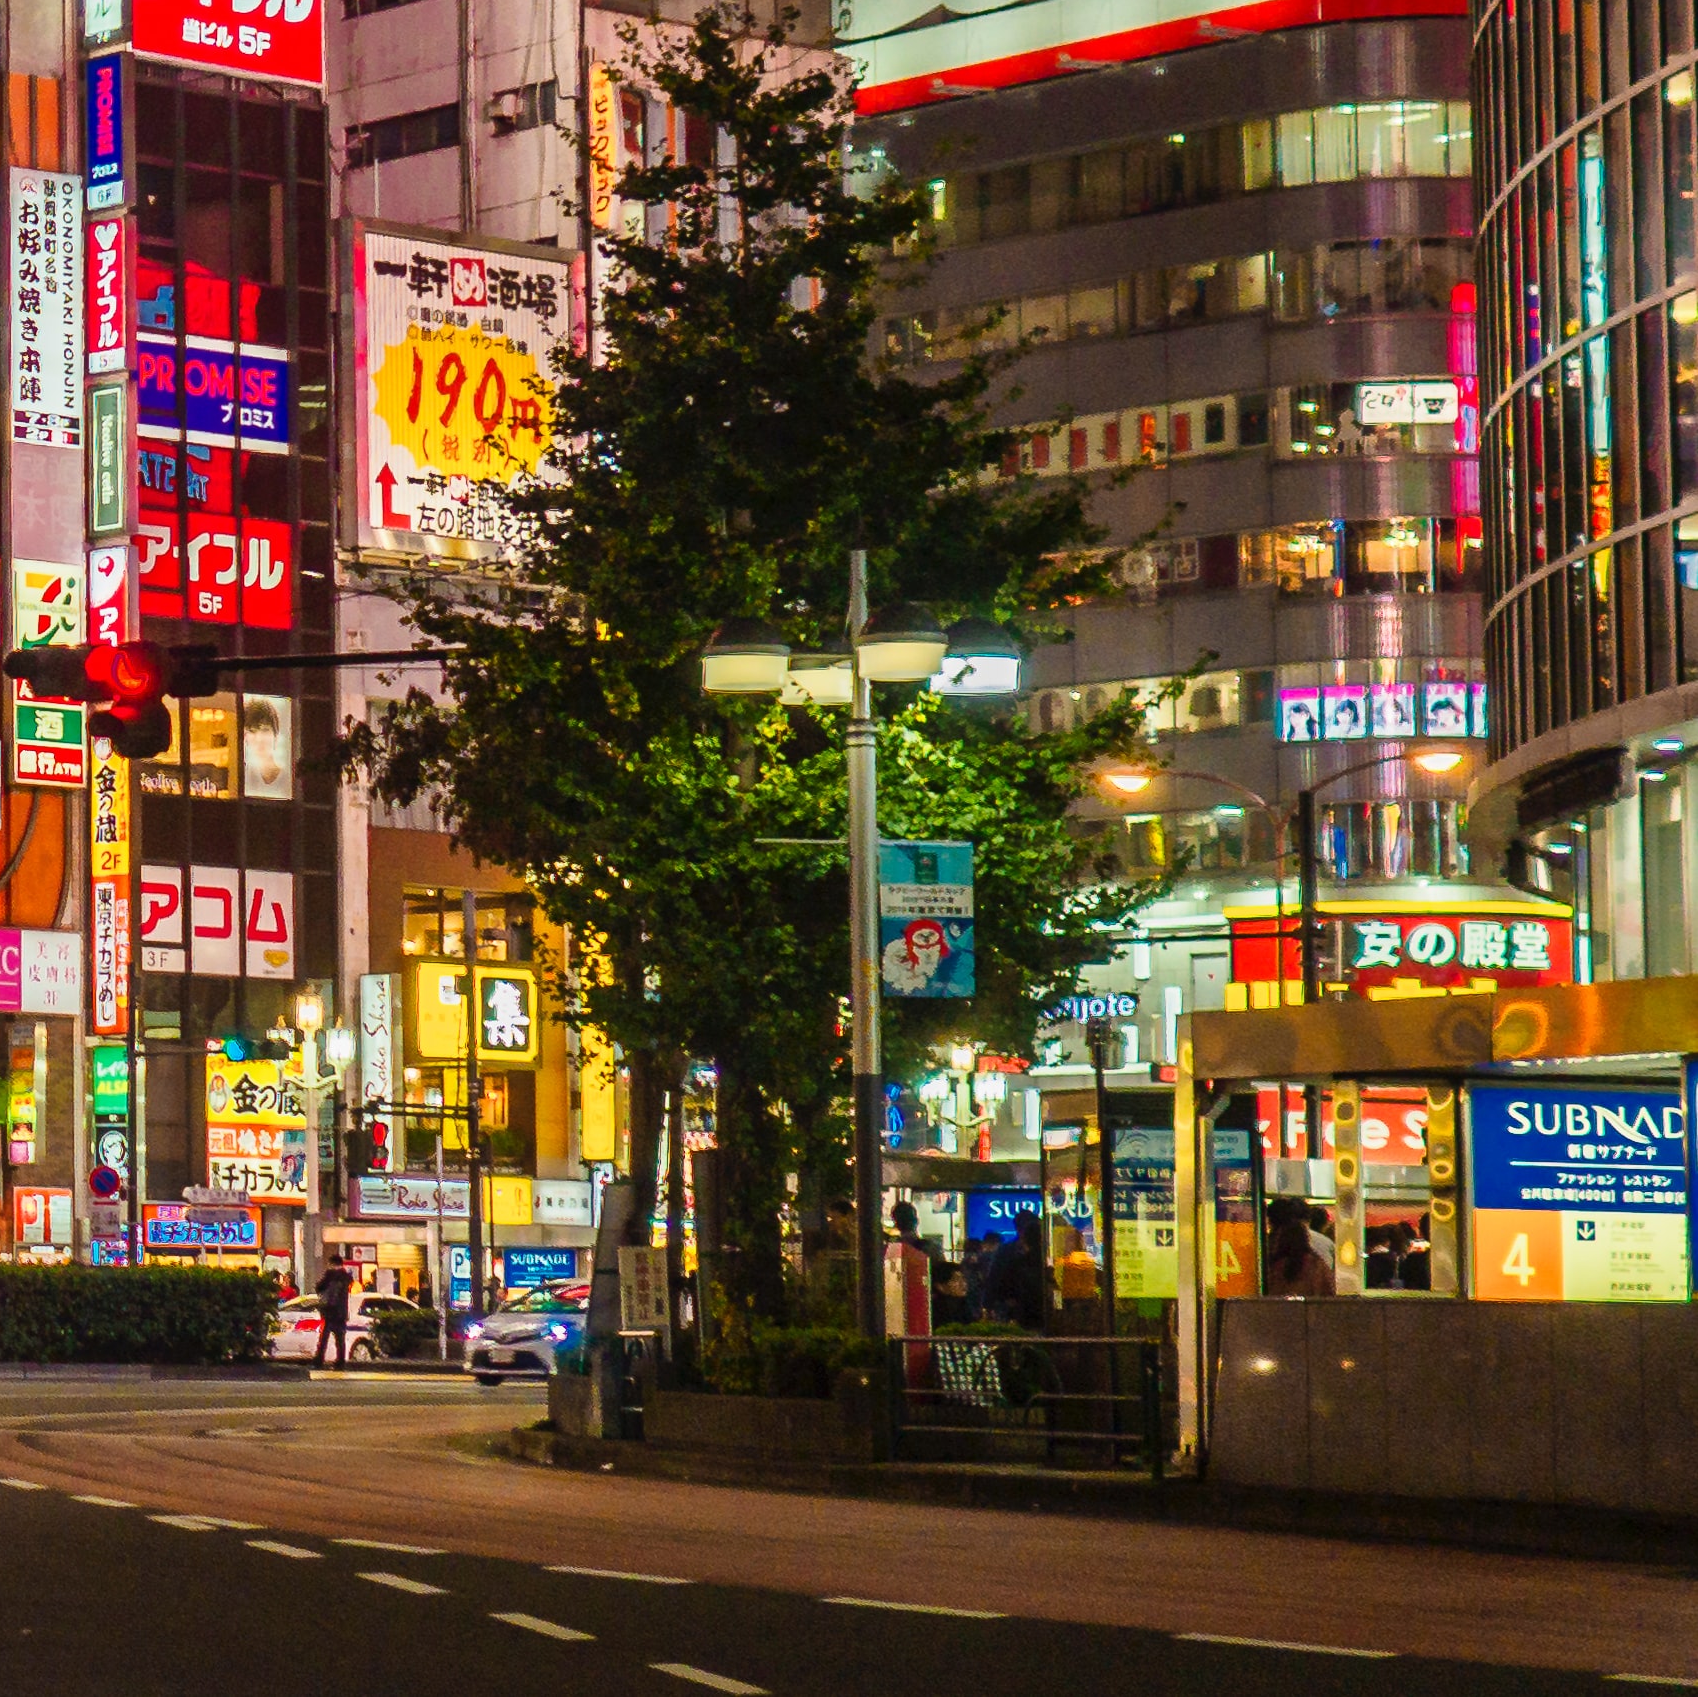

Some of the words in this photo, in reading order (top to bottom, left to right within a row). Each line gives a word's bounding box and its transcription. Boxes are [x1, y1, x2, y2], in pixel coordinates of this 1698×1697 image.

[182, 17, 234, 49] 当ビル
[237, 24, 272, 57] 5F
[96, 66, 115, 157] PROMISE
[61, 180, 75, 325] OKONOMIYAKI
[19, 199, 42, 404] お好み焼き本陣
[96, 249, 120, 350] アイフル
[373, 252, 557, 321] 一軒め酒場
[63, 332, 76, 409] HONJIN
[138, 524, 285, 591] アイフル
[198, 592, 224, 615] 5F
[34, 709, 65, 740] 酒
[19, 750, 56, 776] 銀行
[55, 761, 82, 777] ATM
[93, 765, 119, 843] 金の蔵
[100, 850, 122, 871] 2F
[141, 881, 288, 944] アコム
[97, 887, 114, 1023] 東京チカラめし
[146, 951, 169, 968] 3F
[1555, 1172, 1617, 1187] ファッション
[1622, 1173, 1672, 1188] レストラン
[1567, 1142, 1659, 1161] 新宿サブナード
[1501, 1231, 1536, 1287] 4
